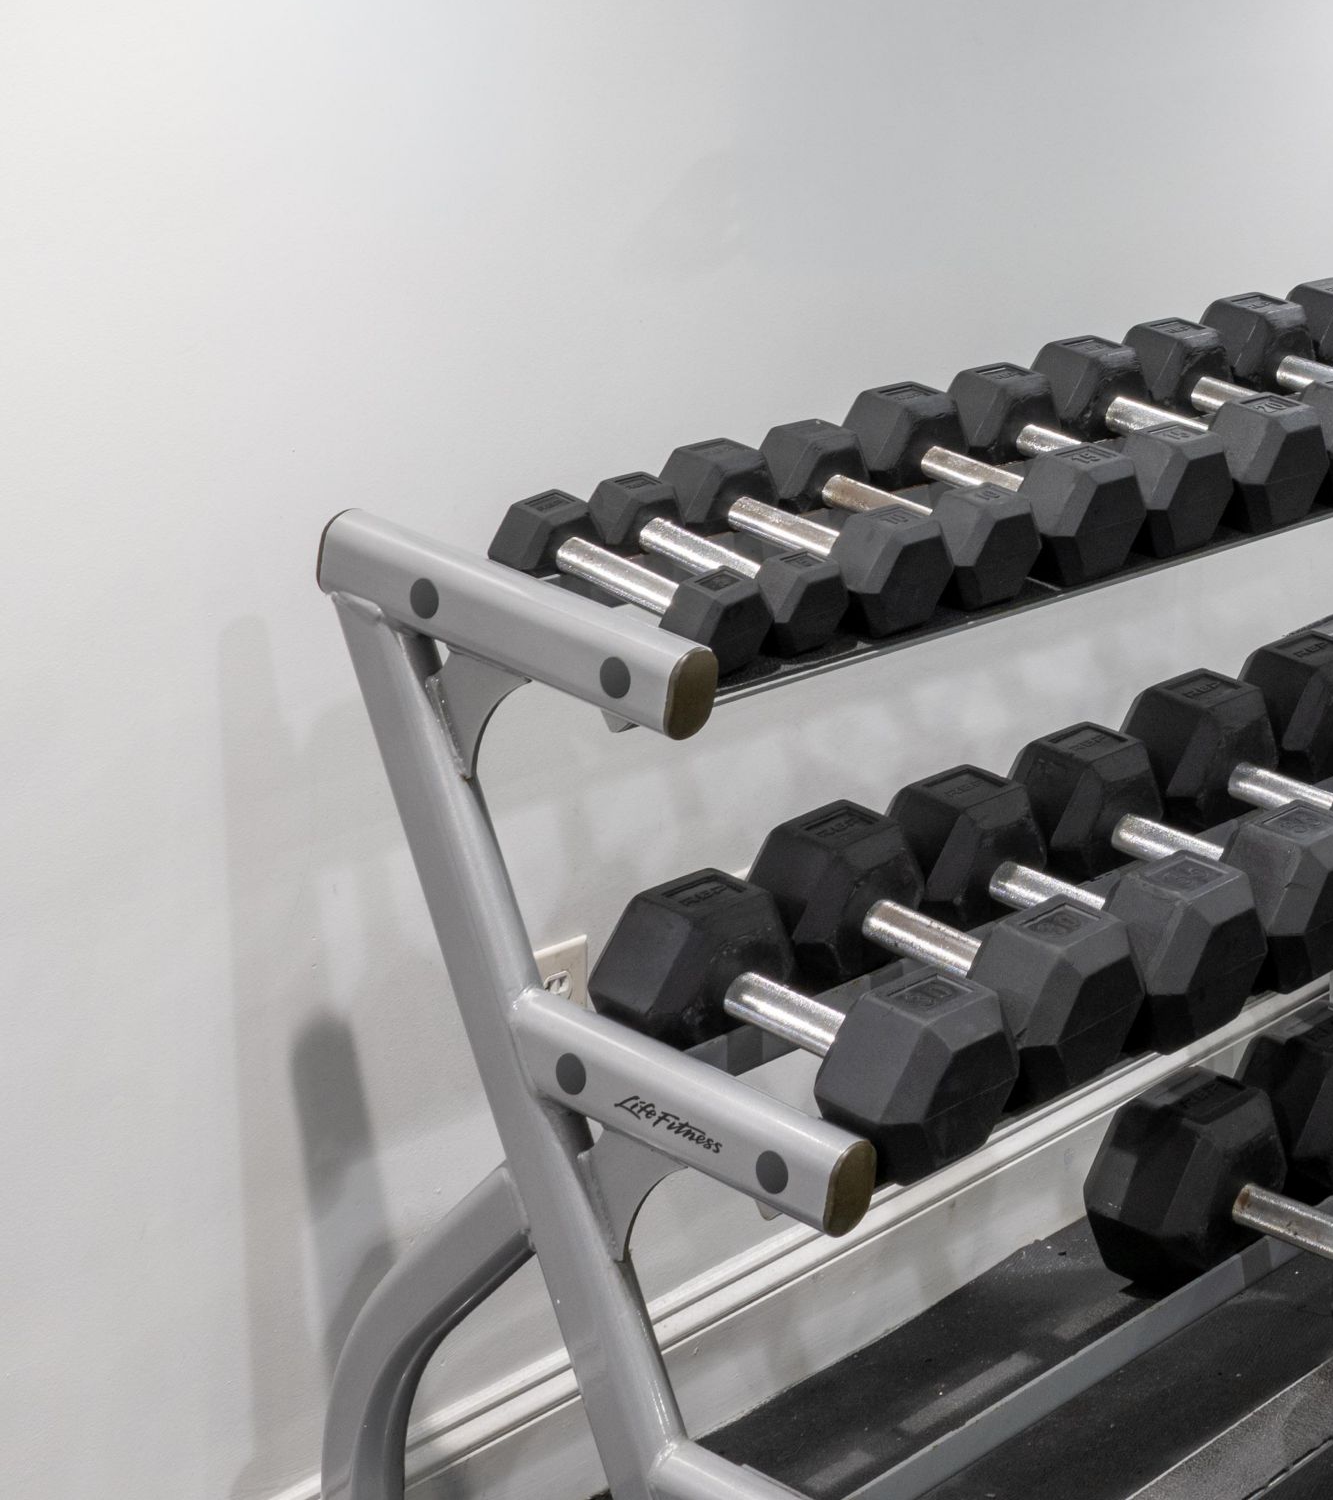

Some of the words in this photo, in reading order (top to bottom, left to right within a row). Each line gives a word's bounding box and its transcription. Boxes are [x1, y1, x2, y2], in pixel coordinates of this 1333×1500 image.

[1293, 639, 1328, 658] REP
[614, 1095, 657, 1121] Life
[652, 1111, 723, 1154] Fitness
